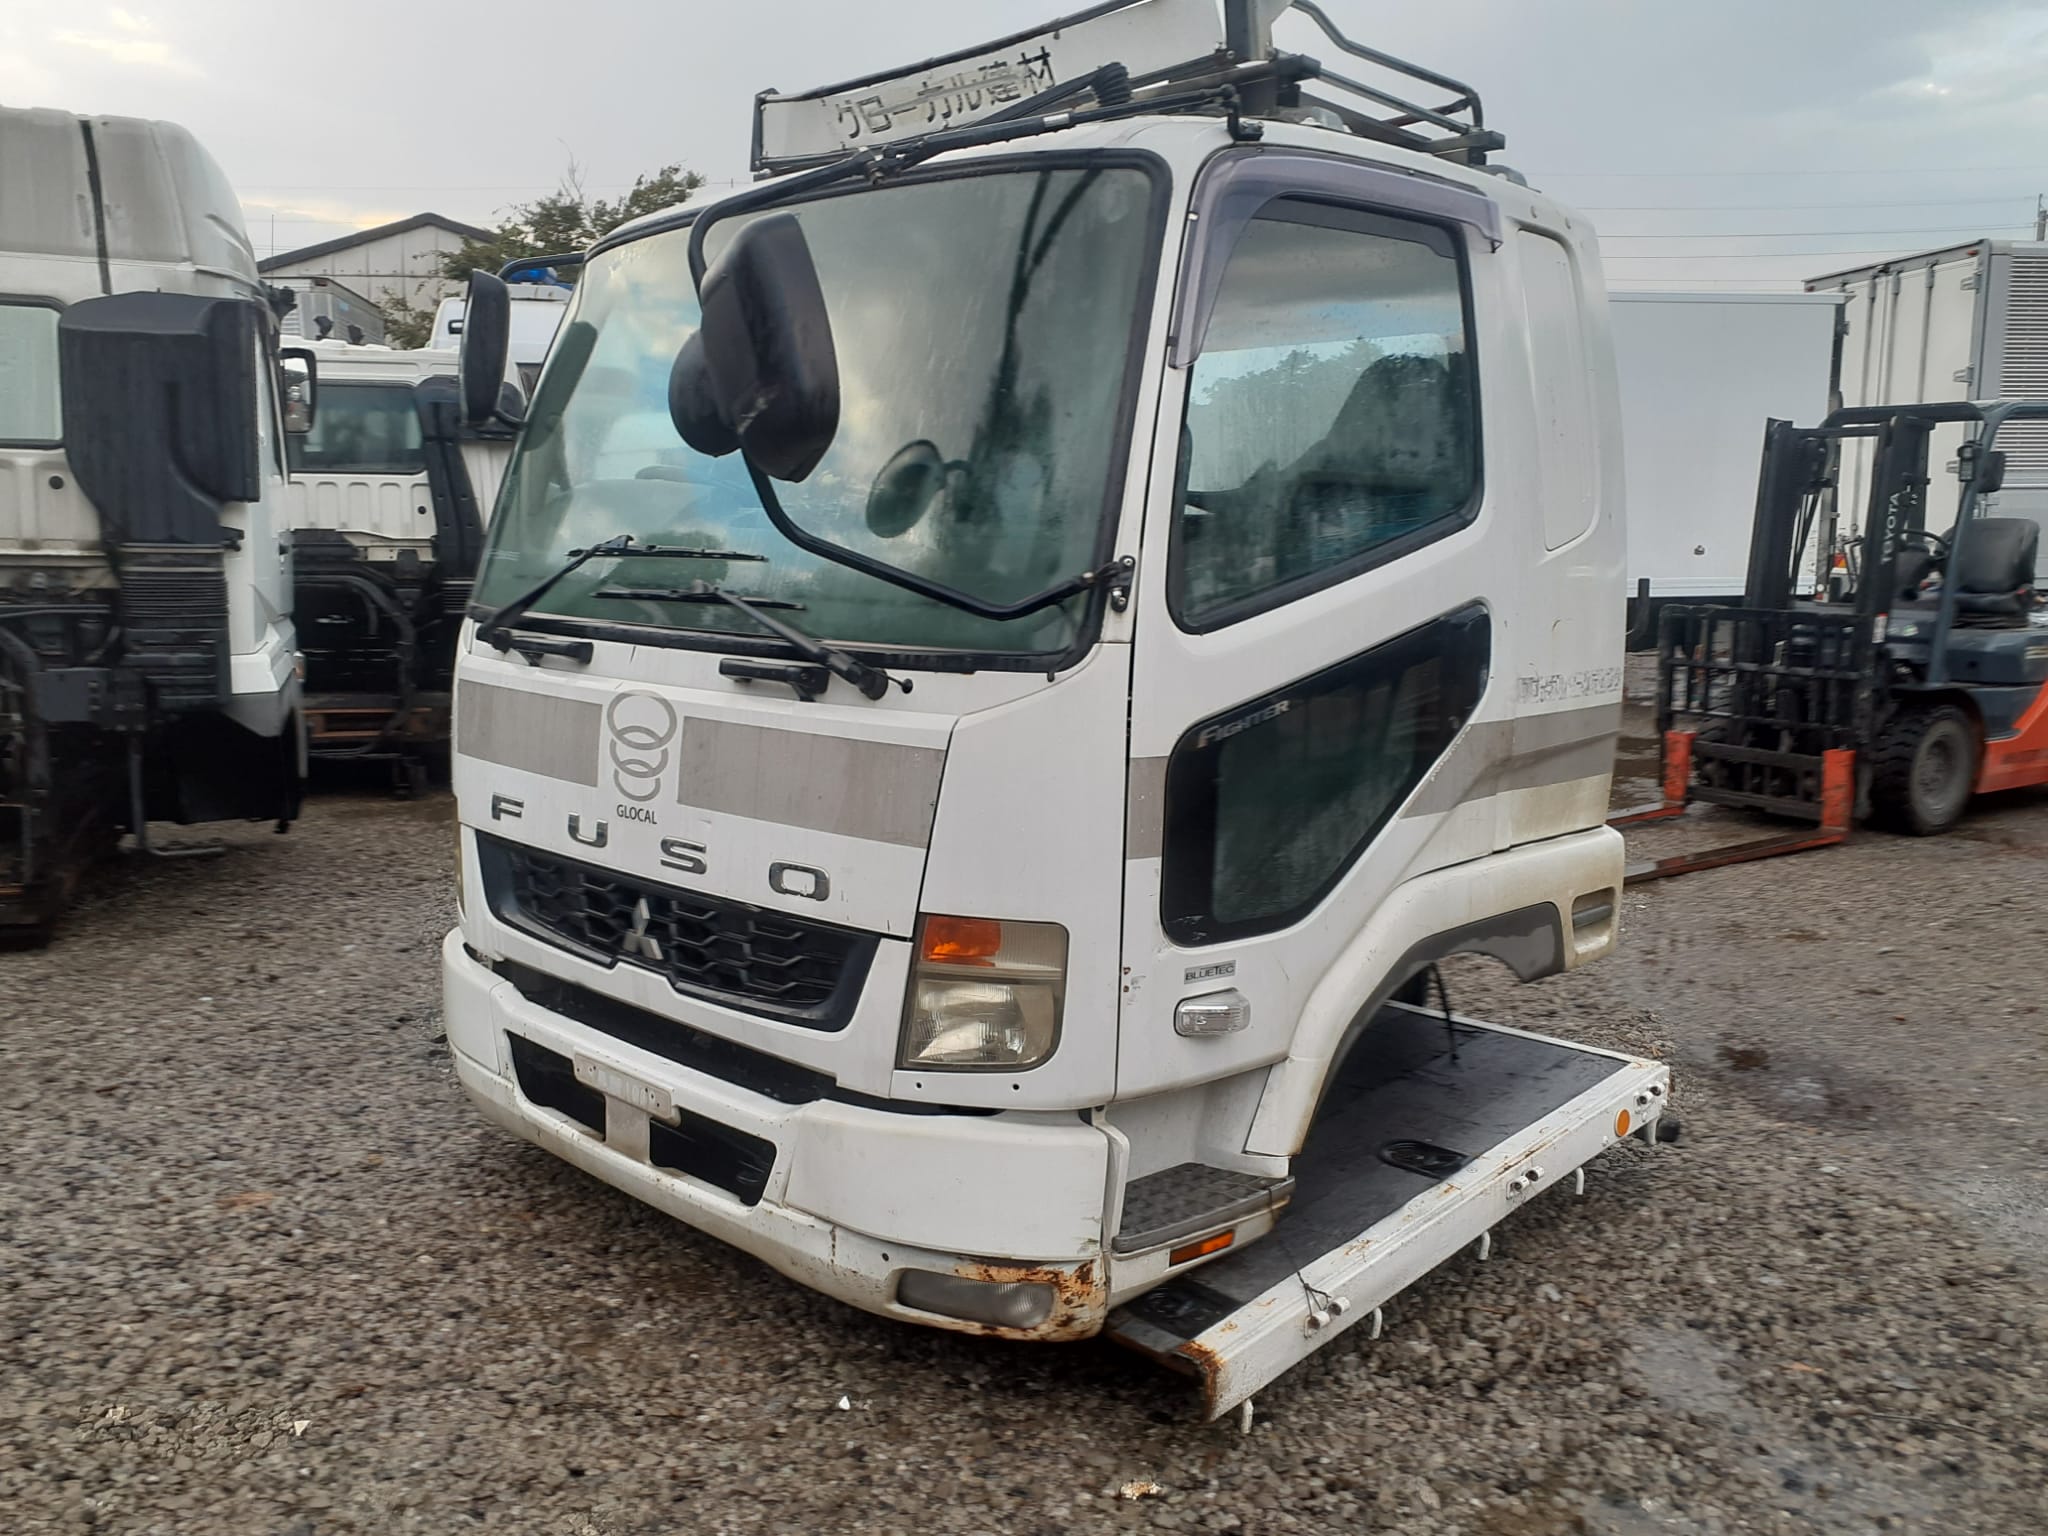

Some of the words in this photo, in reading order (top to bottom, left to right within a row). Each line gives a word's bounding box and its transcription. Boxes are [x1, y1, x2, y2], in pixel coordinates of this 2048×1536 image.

[1881, 493, 1900, 565] TOYOTA
[1197, 699, 1291, 749] FIGHTER
[616, 804, 658, 825] GLOCAL
[491, 791, 831, 902] FUSO
[1185, 964, 1236, 982] BLUETEC
